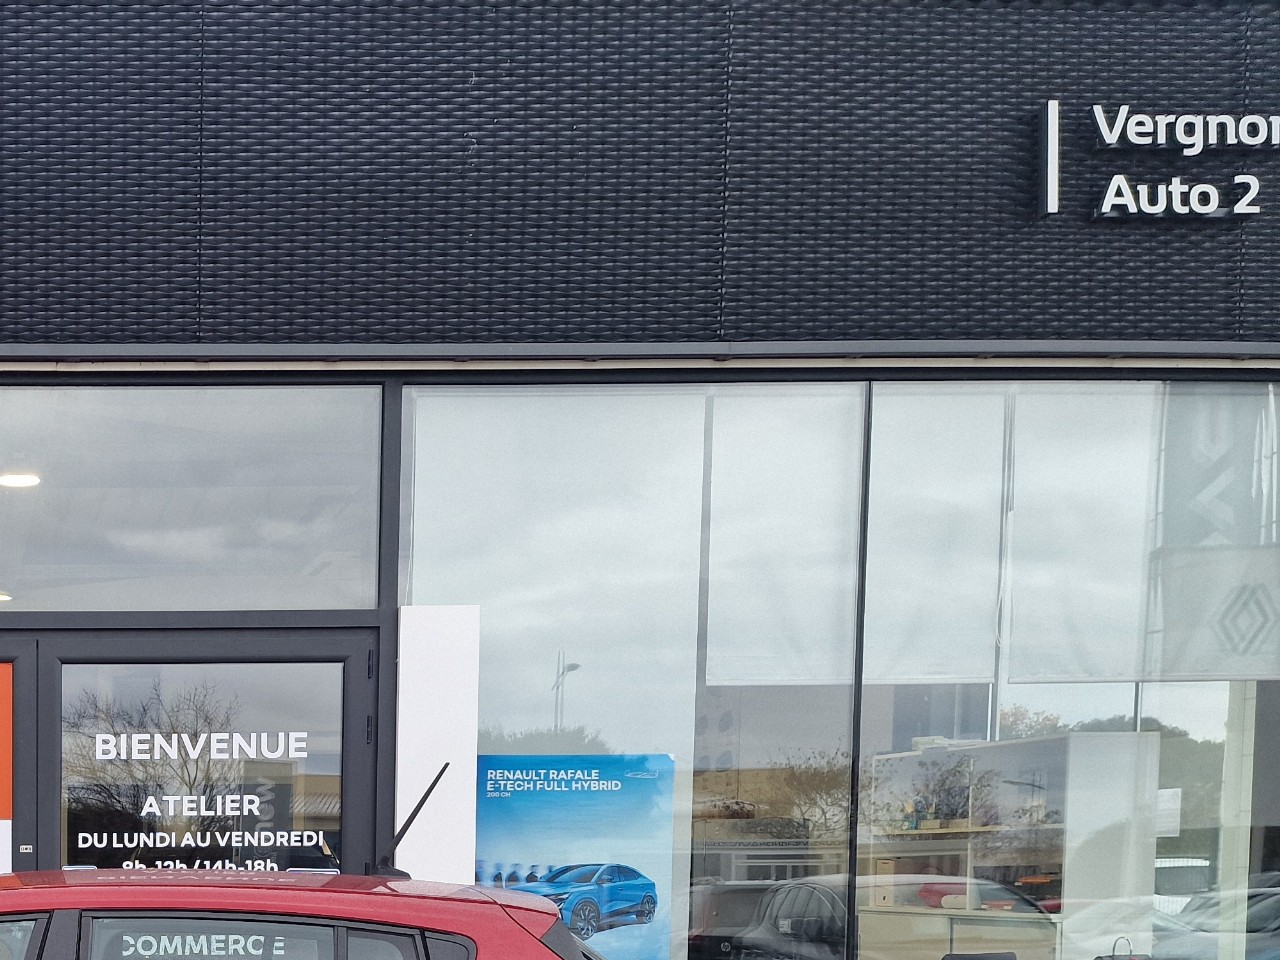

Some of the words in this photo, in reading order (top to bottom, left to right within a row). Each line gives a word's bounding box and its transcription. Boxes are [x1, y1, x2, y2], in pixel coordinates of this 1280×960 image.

[1092, 104, 1280, 157] Vergno
[1101, 174, 1220, 214] Auto
[1232, 174, 1261, 214] 2
[95, 731, 308, 760] BIENVENUE
[486, 780, 534, 792] E-TECH
[536, 780, 569, 791] FULL
[571, 780, 622, 791] HYBRID
[487, 769, 547, 780] RENAULT
[549, 769, 600, 780] RAFALE
[140, 794, 261, 817] ATELIER
[77, 832, 108, 849] DU
[112, 832, 176, 848] LUNDI
[180, 832, 211, 848] AU
[215, 830, 324, 848] VENDREDI
